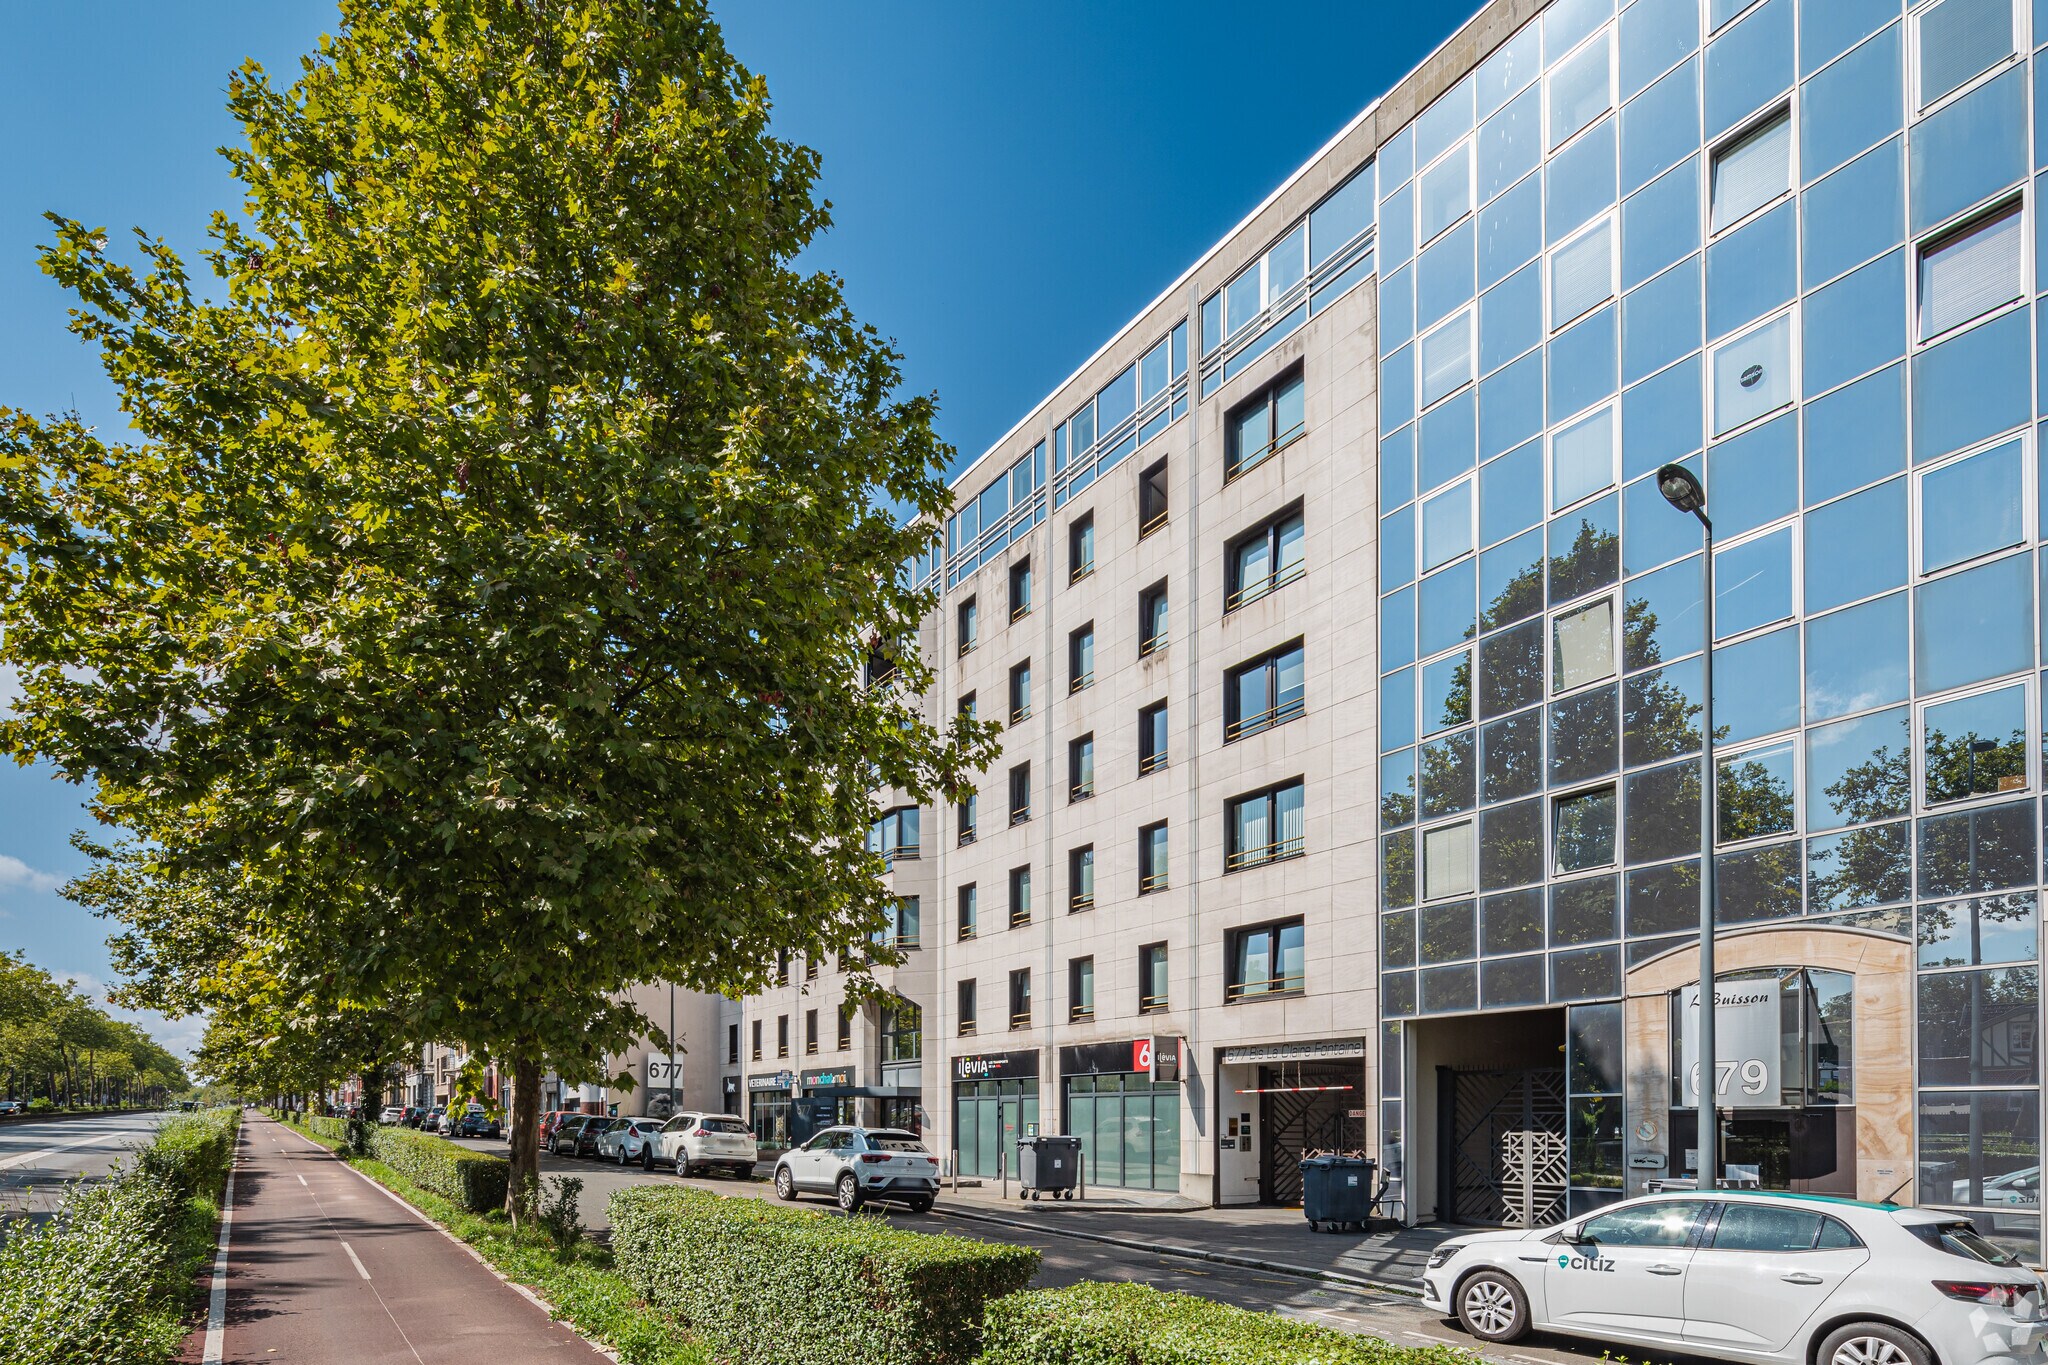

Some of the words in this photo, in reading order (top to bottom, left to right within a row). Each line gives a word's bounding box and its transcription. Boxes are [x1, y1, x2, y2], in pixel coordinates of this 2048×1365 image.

[1139, 1044, 1150, 1067] 6
[1228, 1047, 1247, 1061] 677
[1250, 1046, 1263, 1060] Bis
[1267, 1045, 1277, 1058] La
[1281, 1043, 1311, 1058] Claire
[1315, 1041, 1361, 1056] Fontaine
[649, 1062, 682, 1078] 677
[1571, 1255, 1615, 1272] citiz
